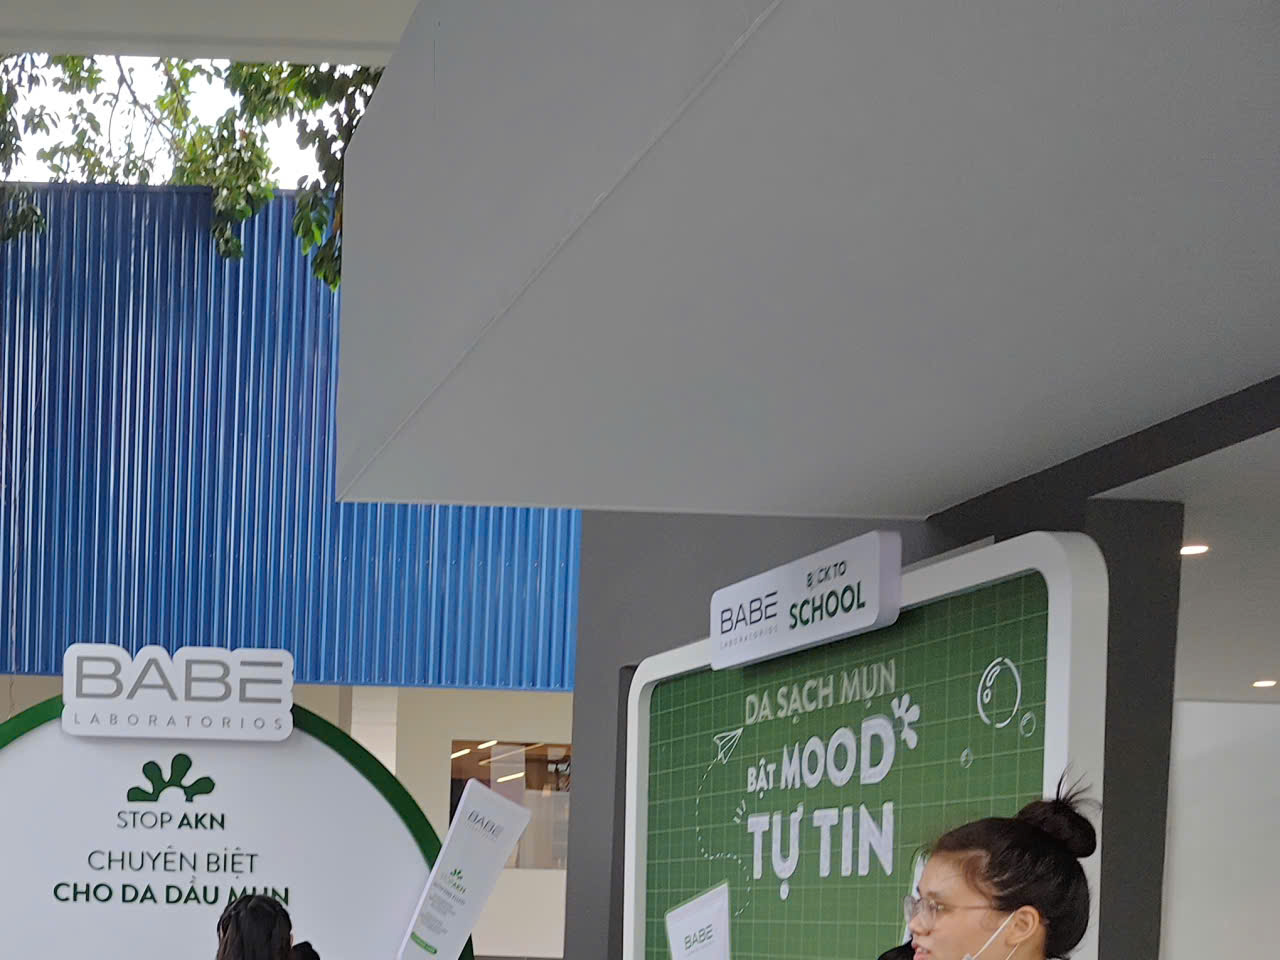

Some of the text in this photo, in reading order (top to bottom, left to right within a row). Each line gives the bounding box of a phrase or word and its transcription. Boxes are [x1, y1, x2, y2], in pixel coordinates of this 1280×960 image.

[832, 559, 847, 578] TO
[720, 580, 867, 635] BABE SCHOOL
[75, 656, 283, 704] BABE
[745, 657, 896, 726] DA SẠCH MỤN
[74, 713, 282, 730] LABORATORIOS
[747, 713, 897, 800] BẬT MOOD
[117, 810, 225, 830] STOP AKN
[88, 845, 197, 872] CHUYÊN
[747, 801, 894, 900] TỰ TIN
[53, 882, 113, 903] CHO
[121, 884, 158, 904] DA
[683, 923, 714, 950] BABE
